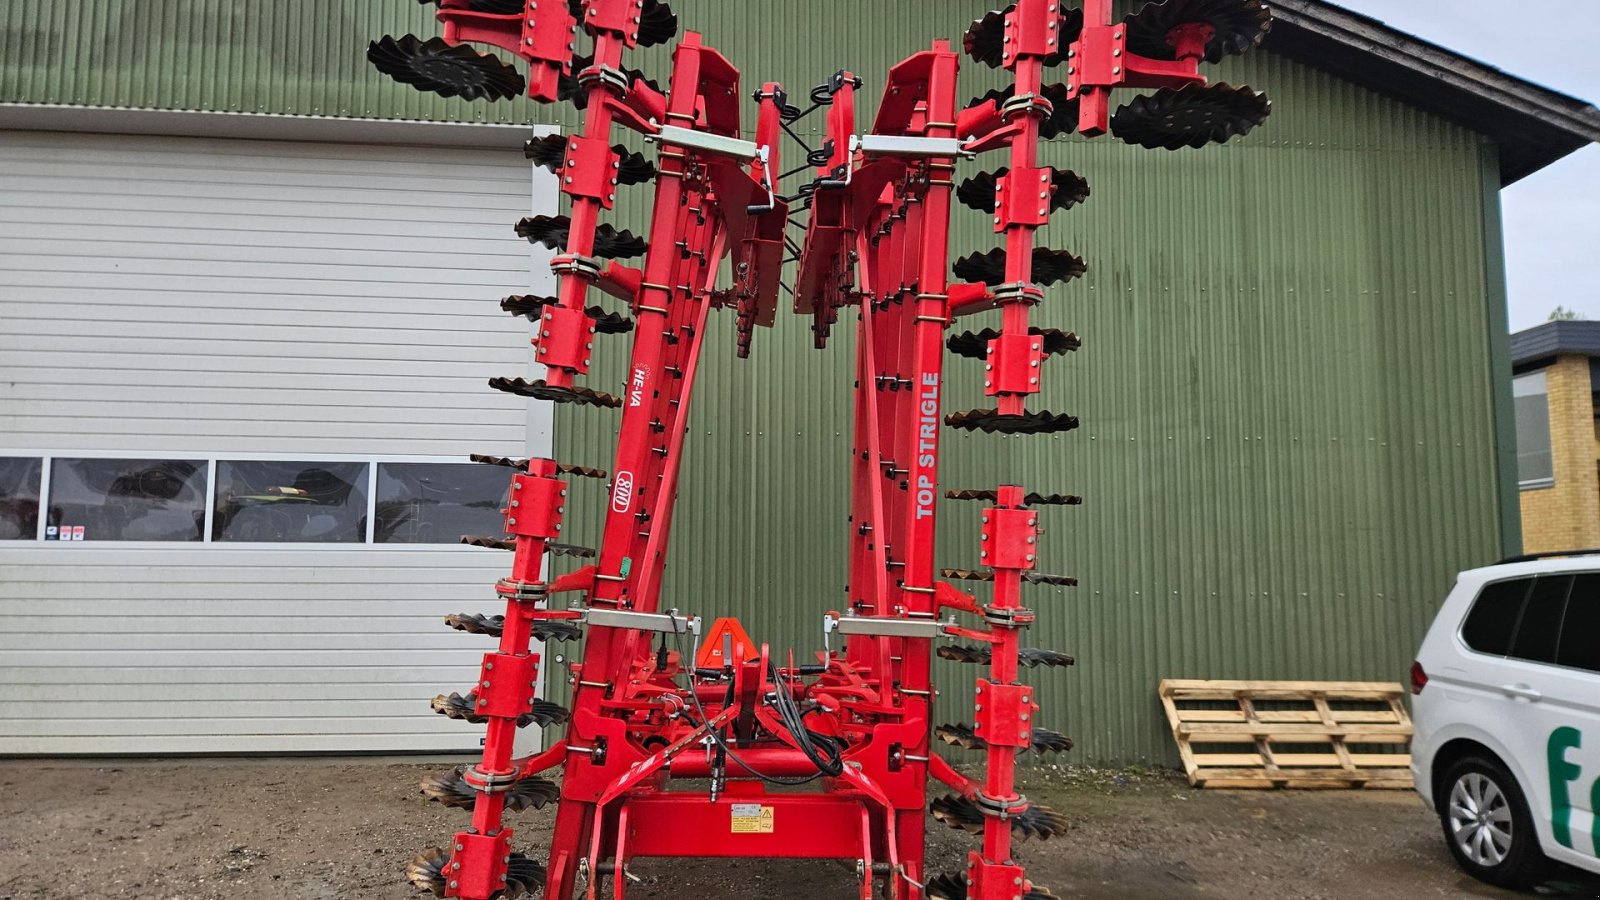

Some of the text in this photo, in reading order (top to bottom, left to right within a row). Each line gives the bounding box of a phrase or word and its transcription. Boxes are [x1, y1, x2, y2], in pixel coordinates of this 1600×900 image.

[629, 368, 645, 407] HE-VA
[916, 372, 939, 520] TOP STRIGLE
[615, 477, 631, 506] 800
[1547, 726, 1600, 859] f
